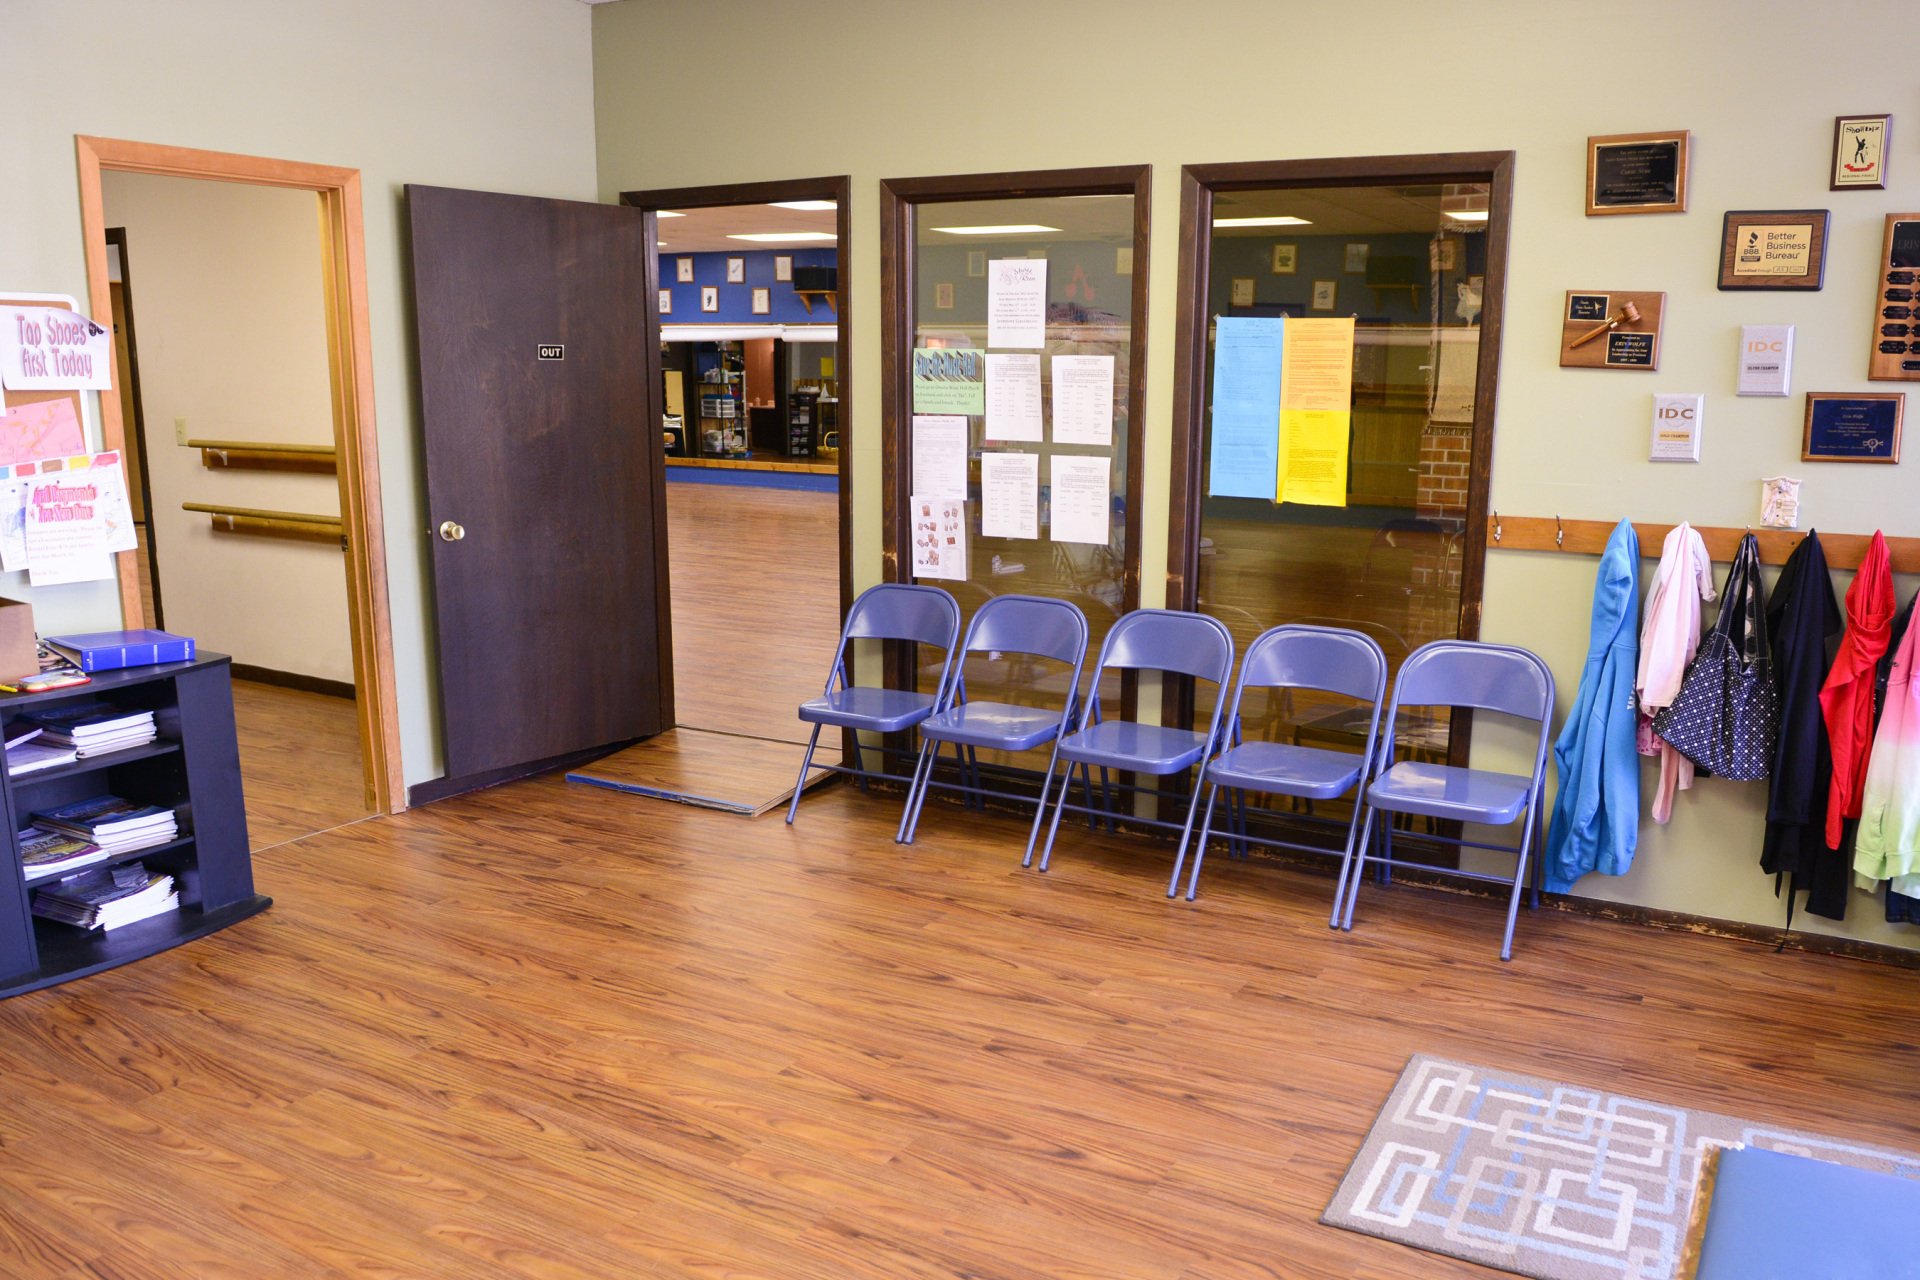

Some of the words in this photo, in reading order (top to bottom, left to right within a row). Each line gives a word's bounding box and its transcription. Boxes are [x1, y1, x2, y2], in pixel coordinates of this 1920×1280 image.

[1767, 232, 1797, 240] Better
[1766, 242, 1807, 250] Business
[1765, 251, 1799, 260] Bureau
[16, 314, 42, 348] Tap
[46, 314, 87, 346] Shoes
[541, 347, 561, 357] OUT
[1748, 341, 1783, 353] IDC
[51, 347, 93, 380] Today
[1658, 408, 1694, 420] IDC
